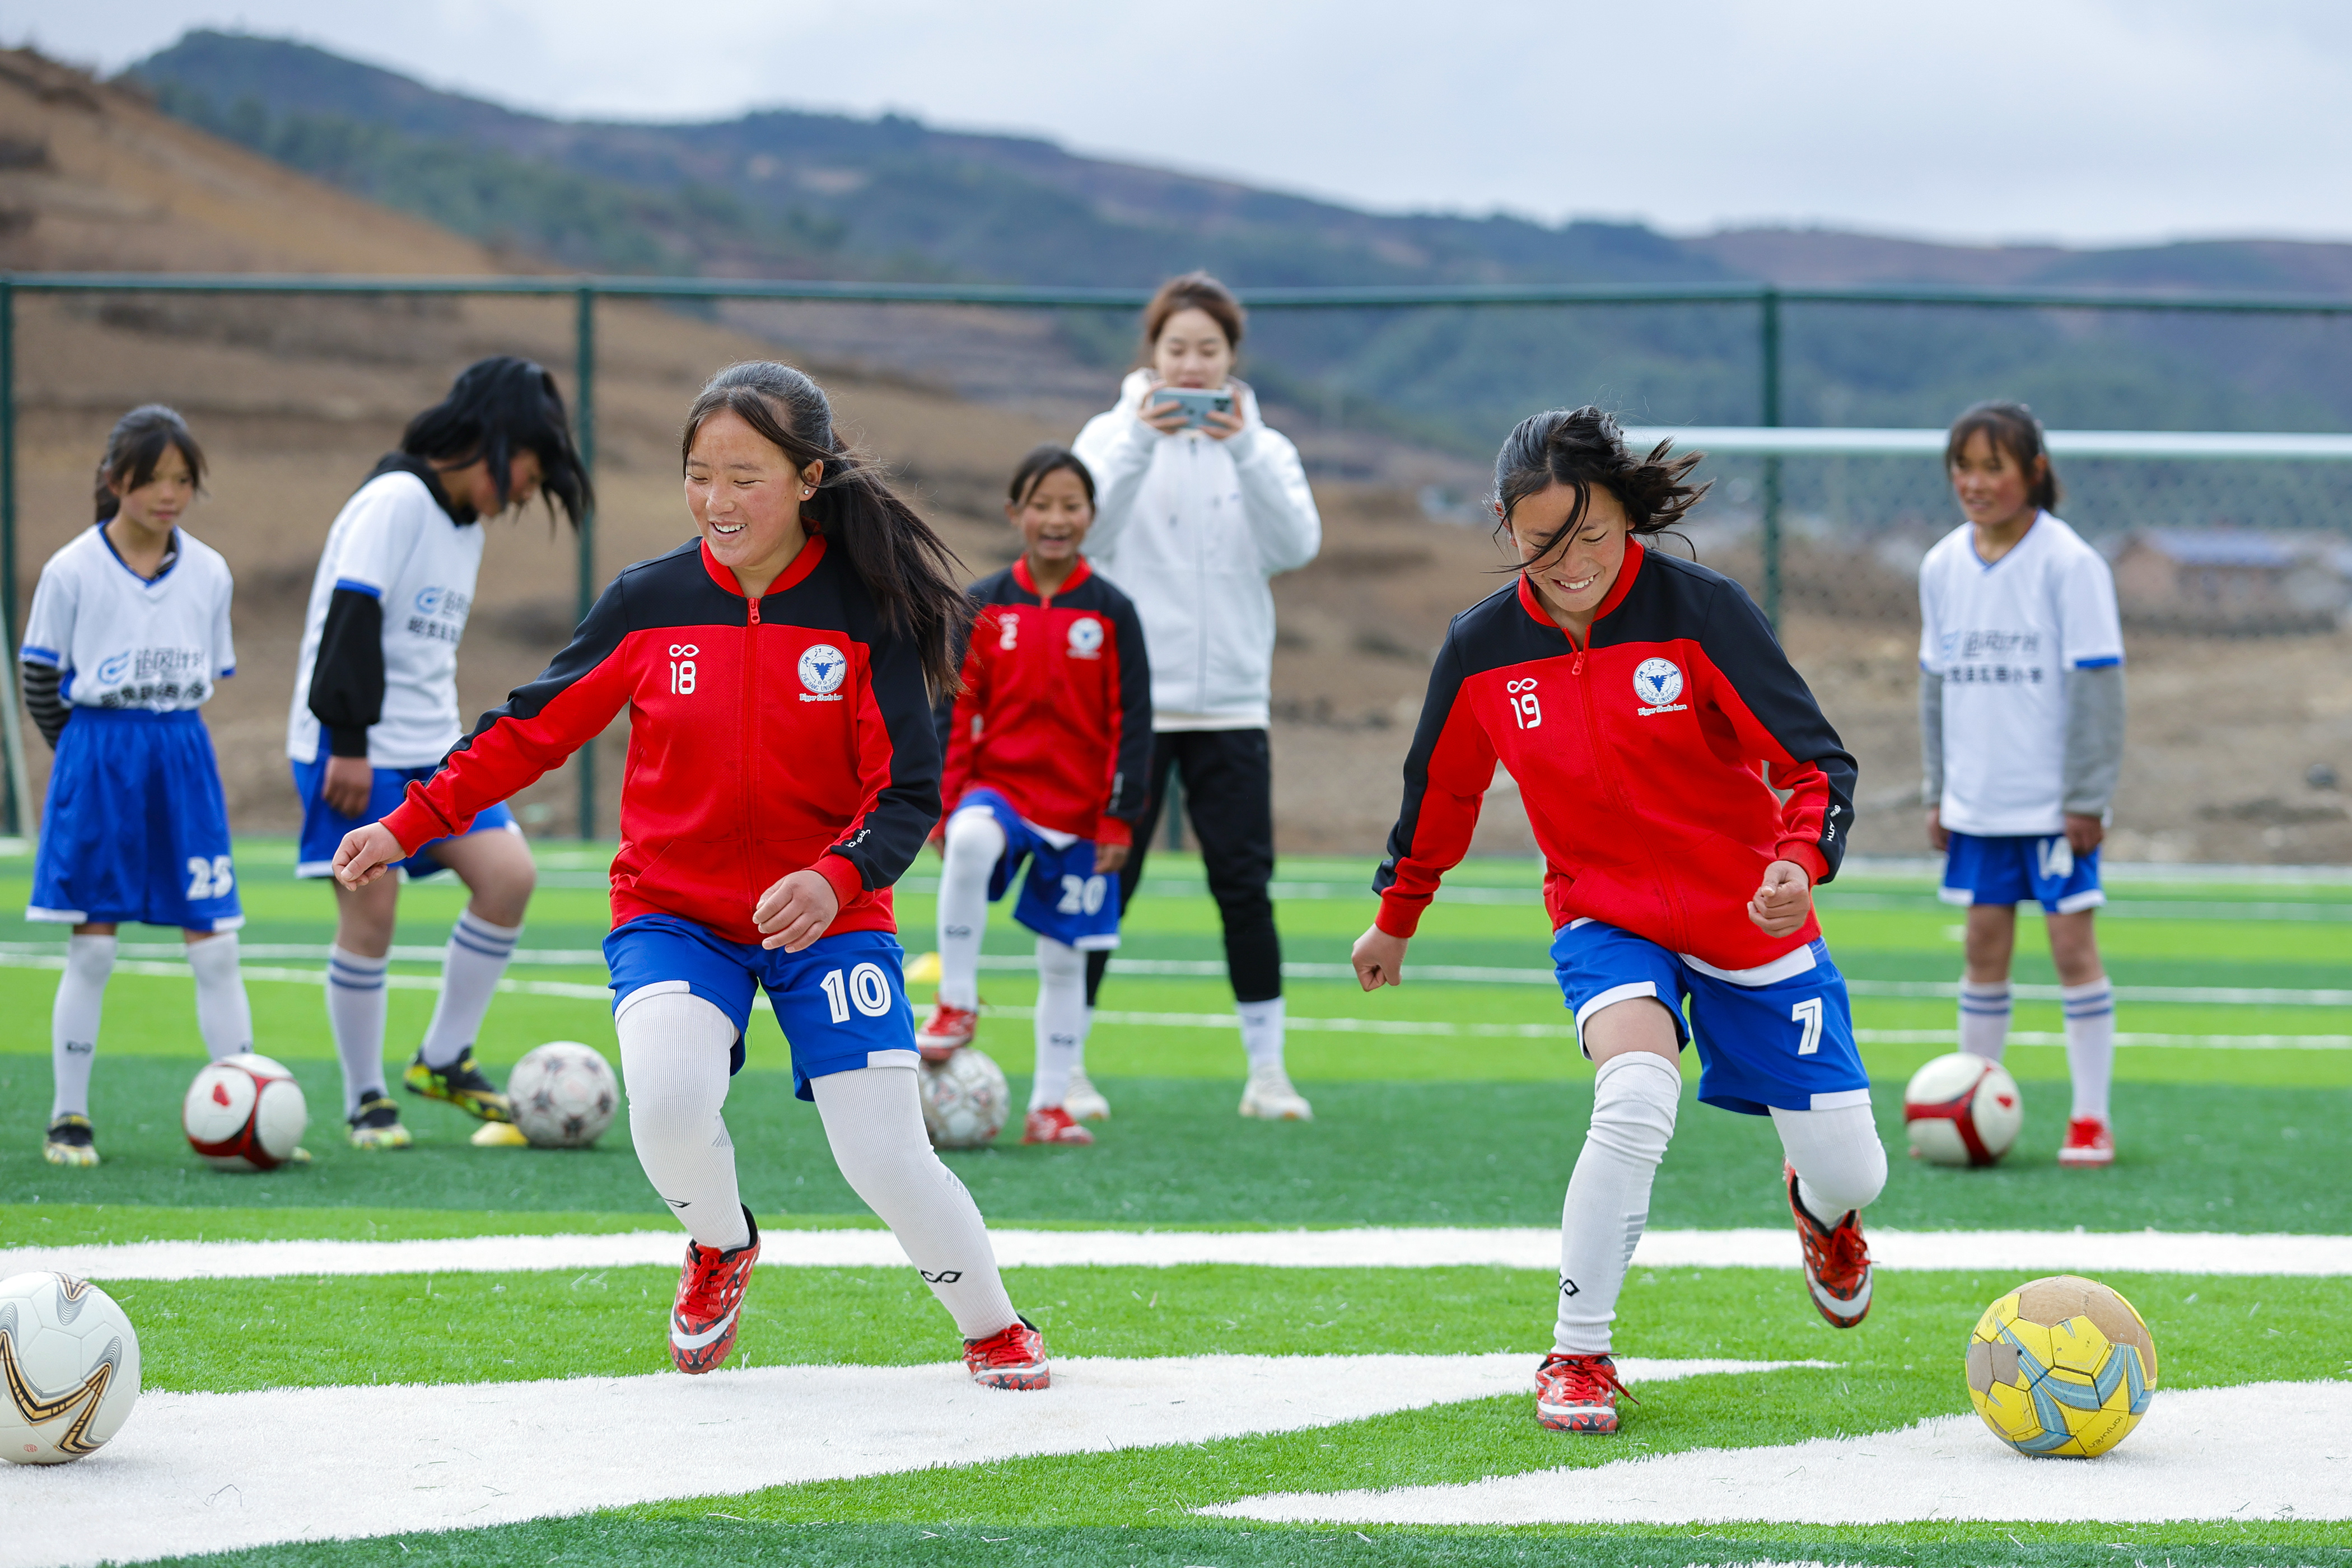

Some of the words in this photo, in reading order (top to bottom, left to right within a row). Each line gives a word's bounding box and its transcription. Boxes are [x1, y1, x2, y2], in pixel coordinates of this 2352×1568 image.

[670, 660, 696, 694] 18
[801, 673, 819, 691] ZHEJIANG
[821, 673, 844, 692] UNIVERSITY
[1637, 687, 1657, 703] ZHEJIANG
[1659, 683, 1680, 703] UNIVERSITY
[1510, 693, 1542, 730] 19
[1638, 707, 1656, 716] Bigger
[185, 856, 234, 901] 25
[1056, 874, 1108, 916] 20
[820, 962, 892, 1024] 10
[1792, 997, 1823, 1056] 7
